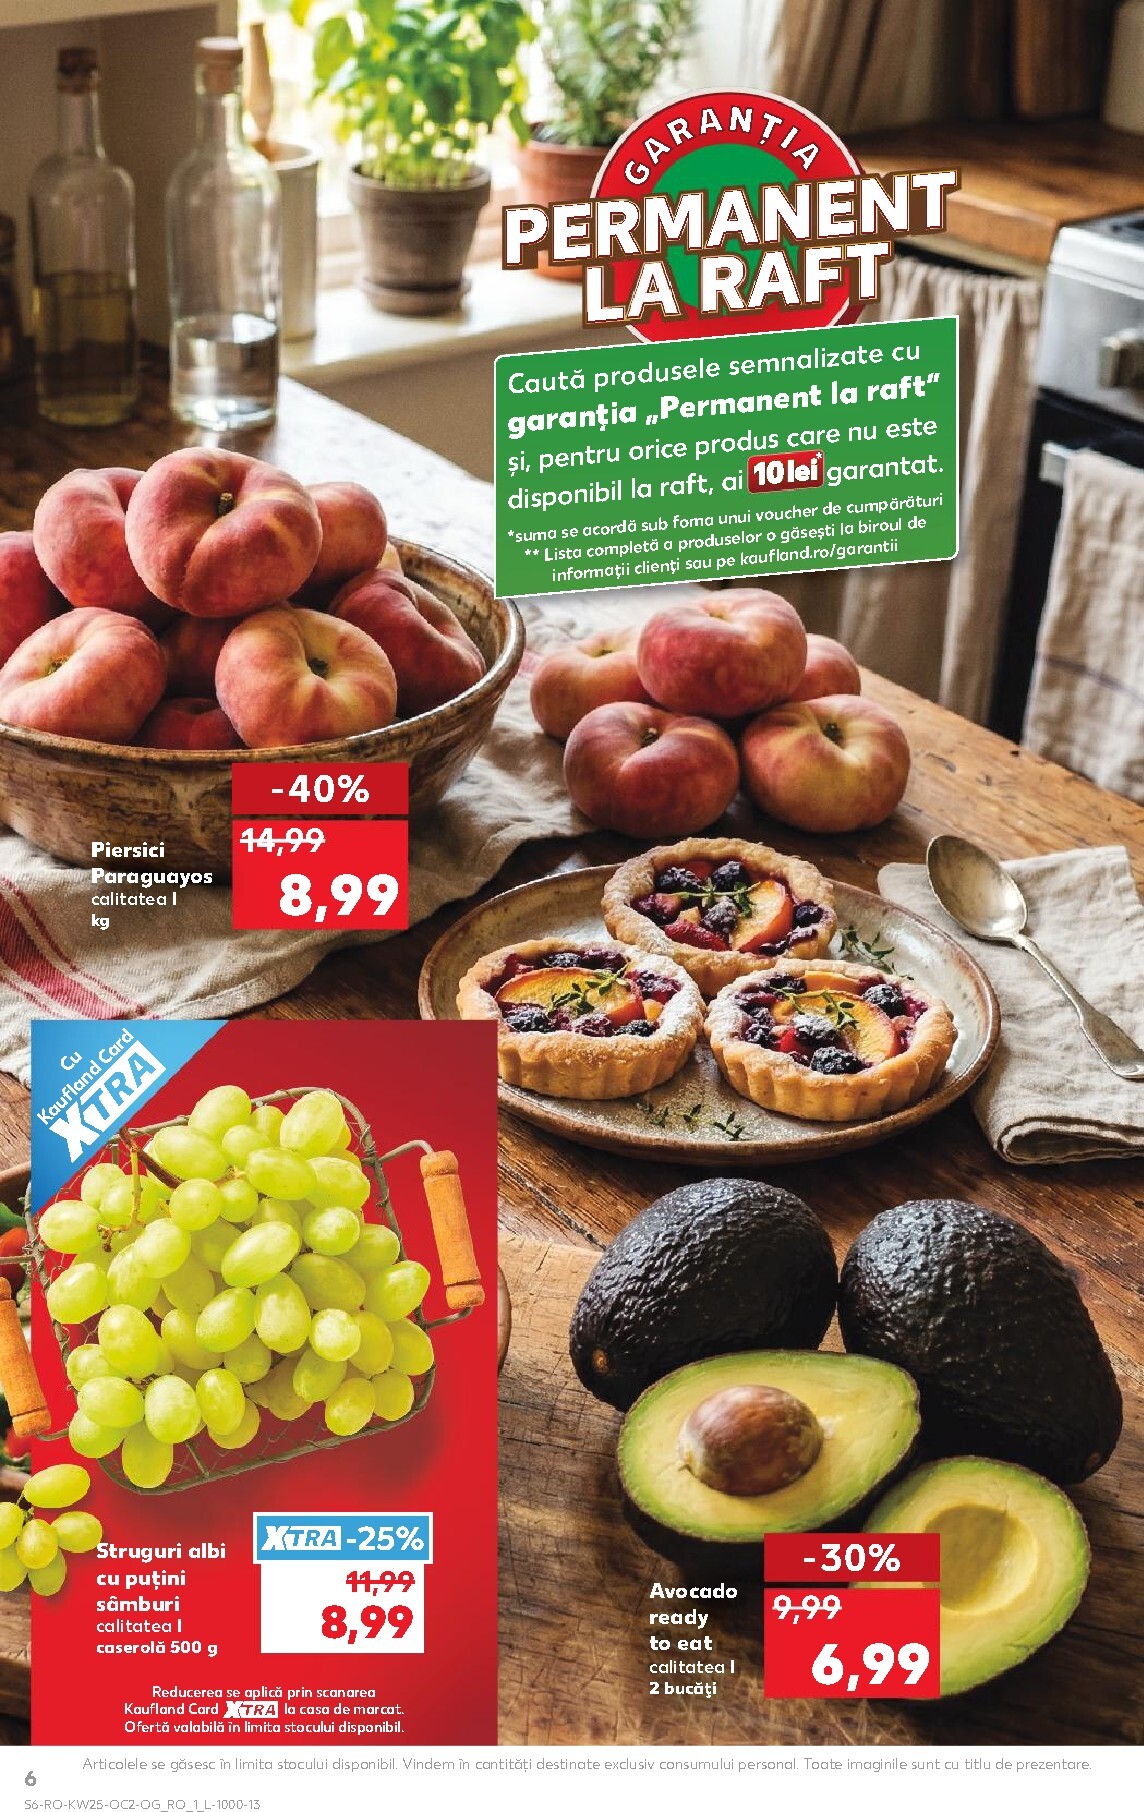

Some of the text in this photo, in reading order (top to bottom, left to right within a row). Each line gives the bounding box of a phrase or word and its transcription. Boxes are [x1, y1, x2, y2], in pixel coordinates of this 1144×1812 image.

[624, 106, 820, 186] GARANȚIA
[504, 170, 957, 265] PERMANENT
[586, 241, 891, 323] LA RAFT
[509, 346, 919, 393] Caută produsele semnalizate cu
[646, 385, 821, 425] „Permanent
[832, 381, 857, 404] la
[540, 446, 619, 473] pentru
[629, 439, 687, 460] orice
[696, 430, 778, 460] produs
[787, 429, 840, 447] care
[849, 426, 876, 441] nu
[886, 418, 937, 438] este
[508, 480, 621, 511] disponibil
[632, 478, 651, 498] la
[661, 473, 713, 496] raft,
[722, 470, 742, 491] ai
[827, 455, 943, 486] garantat.
[562, 528, 578, 538] se
[583, 520, 636, 536] acordă
[642, 517, 668, 531] sub
[673, 515, 713, 528] foma
[719, 510, 750, 524] unui
[756, 505, 818, 521] voucher
[823, 502, 841, 515] de
[847, 493, 942, 513] cumpărături
[545, 548, 581, 561] Lista
[587, 539, 658, 557] completă
[664, 541, 672, 550] a
[679, 531, 762, 552] produselor
[767, 532, 776, 541] o
[841, 523, 853, 535] la
[859, 518, 901, 533] biroul
[908, 516, 926, 529] de
[686, 559, 711, 569] sau
[717, 557, 735, 570] pe
[741, 534, 897, 565] kaufland.ro/garantii
[272, 775, 369, 802] -40%
[90, 840, 167, 860] Piersici
[239, 826, 327, 858] 14,99
[90, 867, 214, 889] Paraguayos
[90, 890, 169, 908] calitatea
[280, 874, 398, 922] 8,99
[91, 914, 110, 930] kg
[61, 1052, 82, 1070] Cu
[36, 1027, 135, 1126] Kaufland Card
[49, 1040, 167, 1163] XTRA
[261, 1526, 424, 1551] XTRA -25%
[97, 1543, 225, 1563] Struguri albi
[804, 1544, 900, 1571] -30%
[97, 1574, 119, 1585] cu
[346, 1572, 414, 1595] 11,99
[650, 1583, 739, 1600] Avocado
[97, 1596, 179, 1611] sâmburi
[771, 1594, 843, 1624] 9,99
[97, 1619, 171, 1632] calitatea
[322, 1606, 412, 1644] 8,99
[649, 1609, 710, 1630] ready
[97, 1641, 217, 1657] caserolă 500 g
[649, 1635, 714, 1652] to eat
[649, 1660, 726, 1675] calitatea
[812, 1643, 929, 1691] 6,99
[153, 1686, 222, 1697] Reducerea
[245, 1686, 282, 1700] aplică
[288, 1687, 312, 1700] prin
[649, 1681, 661, 1696] 2
[125, 1703, 184, 1714] Kaufland
[189, 1703, 218, 1714] Card
[223, 1701, 279, 1719] XTRA
[285, 1703, 295, 1714] la
[334, 1703, 350, 1714] de
[354, 1704, 404, 1714] marcat.
[125, 1721, 404, 1735] Ofertă valabilă în limita stocului disponibil.
[83, 1758, 147, 1769] Articolele
[171, 1759, 215, 1772] găsesc
[220, 1759, 230, 1769] în
[236, 1758, 272, 1769] limita
[278, 1758, 327, 1769] stocului
[333, 1758, 397, 1772] disponibil.
[403, 1758, 454, 1769] Vindem
[459, 1759, 469, 1769] în
[537, 1758, 600, 1769] destinate
[605, 1758, 654, 1769] exclusiv
[660, 1758, 733, 1769] consumului
[739, 1758, 798, 1772] personal.
[804, 1758, 842, 1769] Toate
[848, 1758, 907, 1772] imaginile
[912, 1759, 940, 1769] sunt
[965, 1758, 990, 1769] titlu
[996, 1758, 1012, 1769] de
[1017, 1759, 1092, 1772] prezentare.
[25, 1771, 36, 1786] 6
